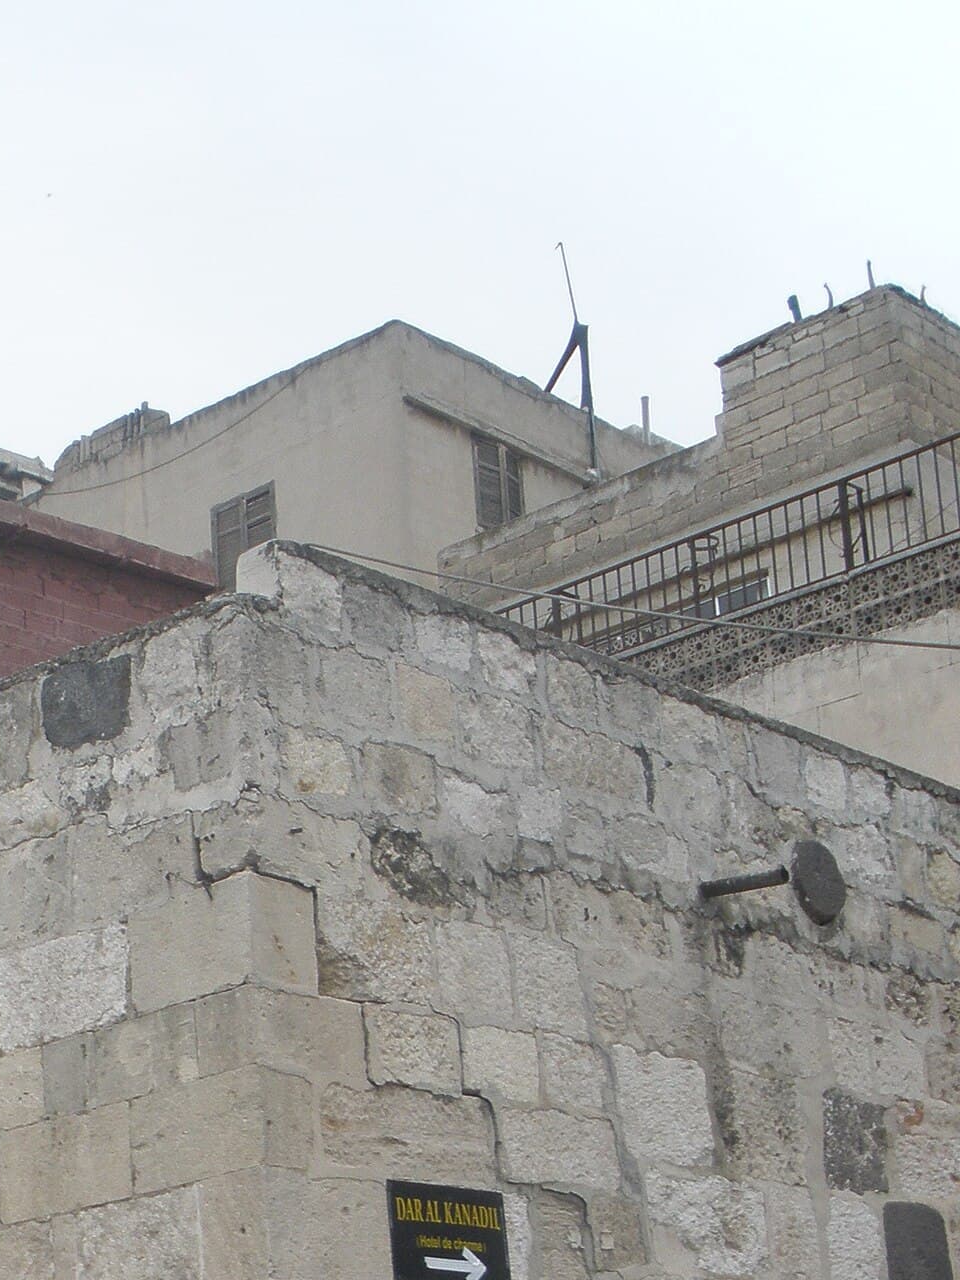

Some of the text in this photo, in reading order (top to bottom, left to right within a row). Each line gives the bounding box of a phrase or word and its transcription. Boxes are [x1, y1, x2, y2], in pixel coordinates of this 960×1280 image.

[395, 1196, 501, 1231] DAR AL KANADIL
[442, 1236, 453, 1250] de
